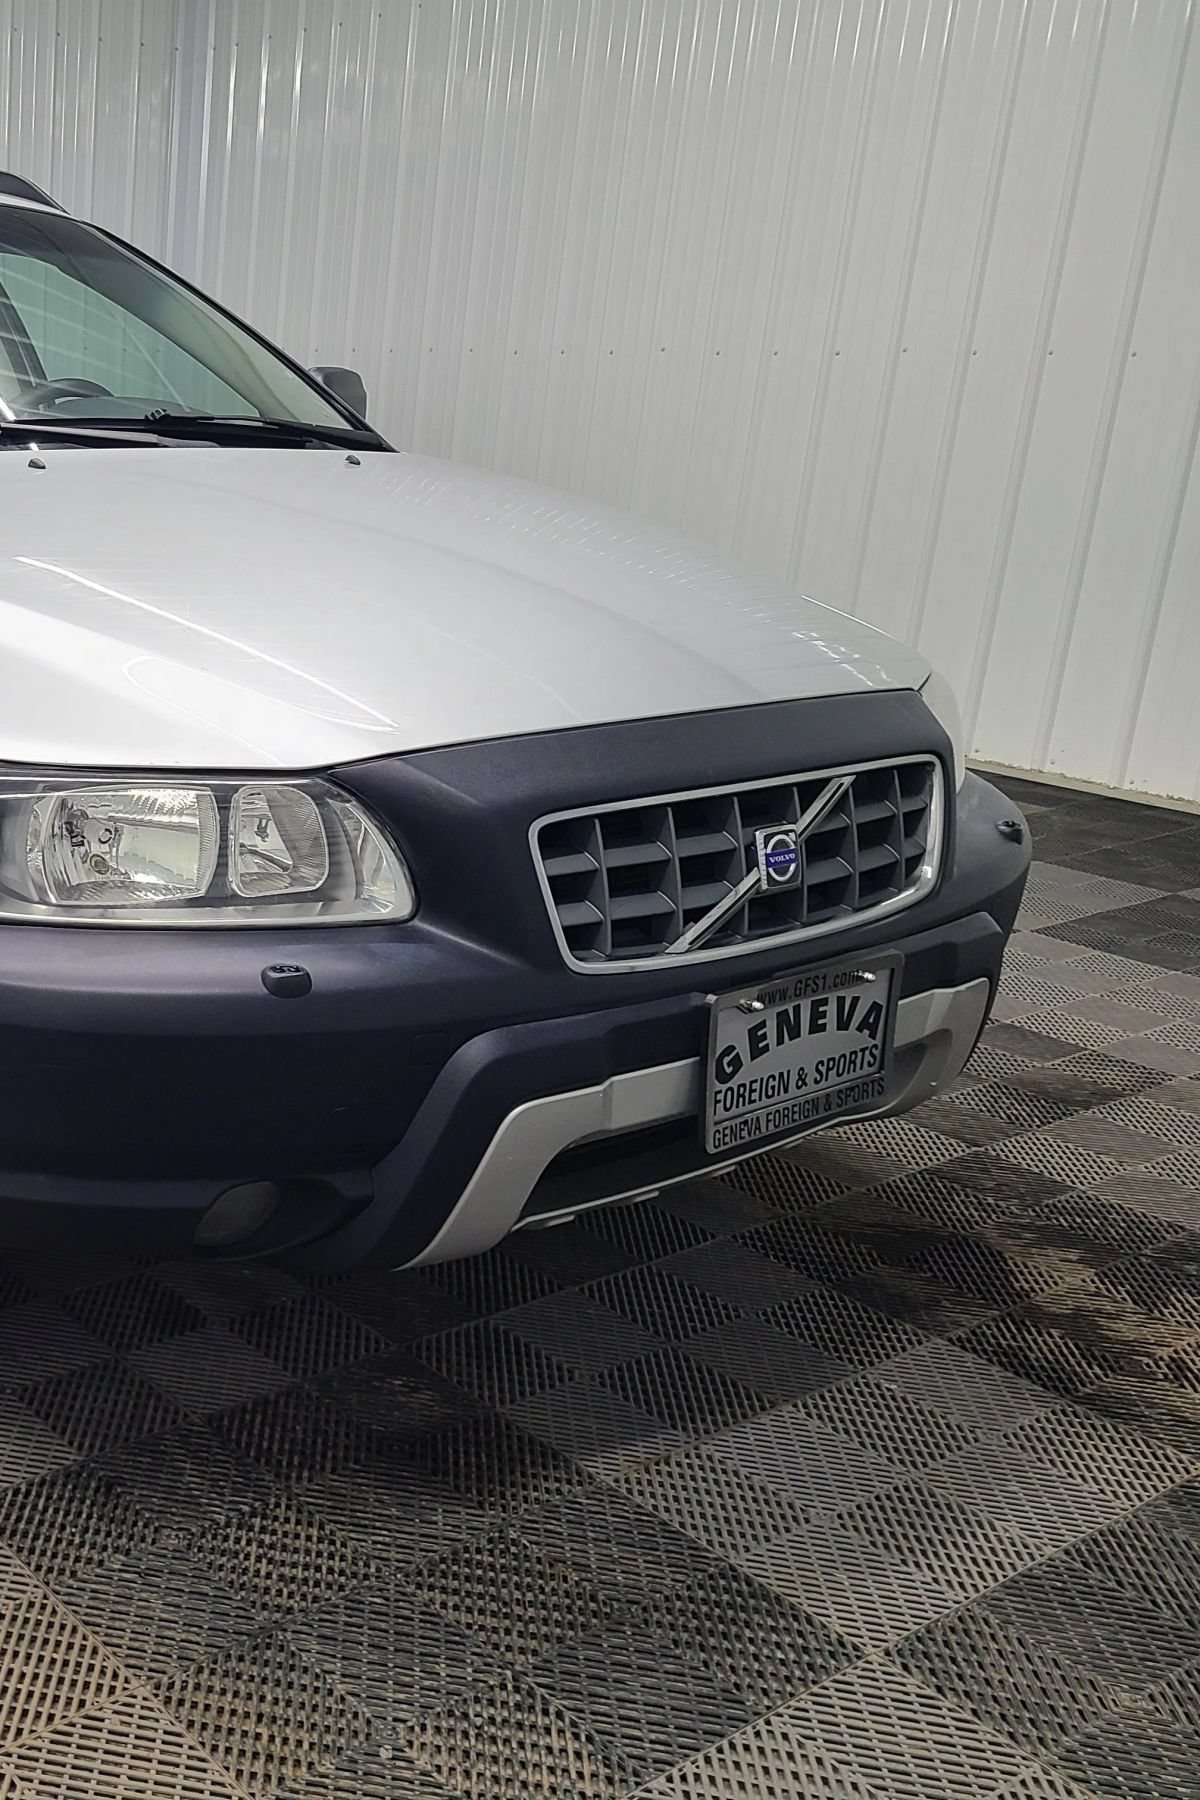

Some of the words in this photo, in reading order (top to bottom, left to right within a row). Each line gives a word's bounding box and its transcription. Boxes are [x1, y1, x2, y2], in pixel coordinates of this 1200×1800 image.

[769, 853, 796, 863] VOLVO
[715, 995, 884, 1085] GENEVA
[712, 1115, 762, 1150] GENEVA
[765, 1097, 820, 1132] FOREIGN
[823, 1093, 832, 1113] &
[836, 1077, 885, 1108] SPORTS
[713, 1069, 791, 1117] FOREIGN
[795, 1066, 808, 1090] &
[813, 1043, 879, 1085] SPORTS
